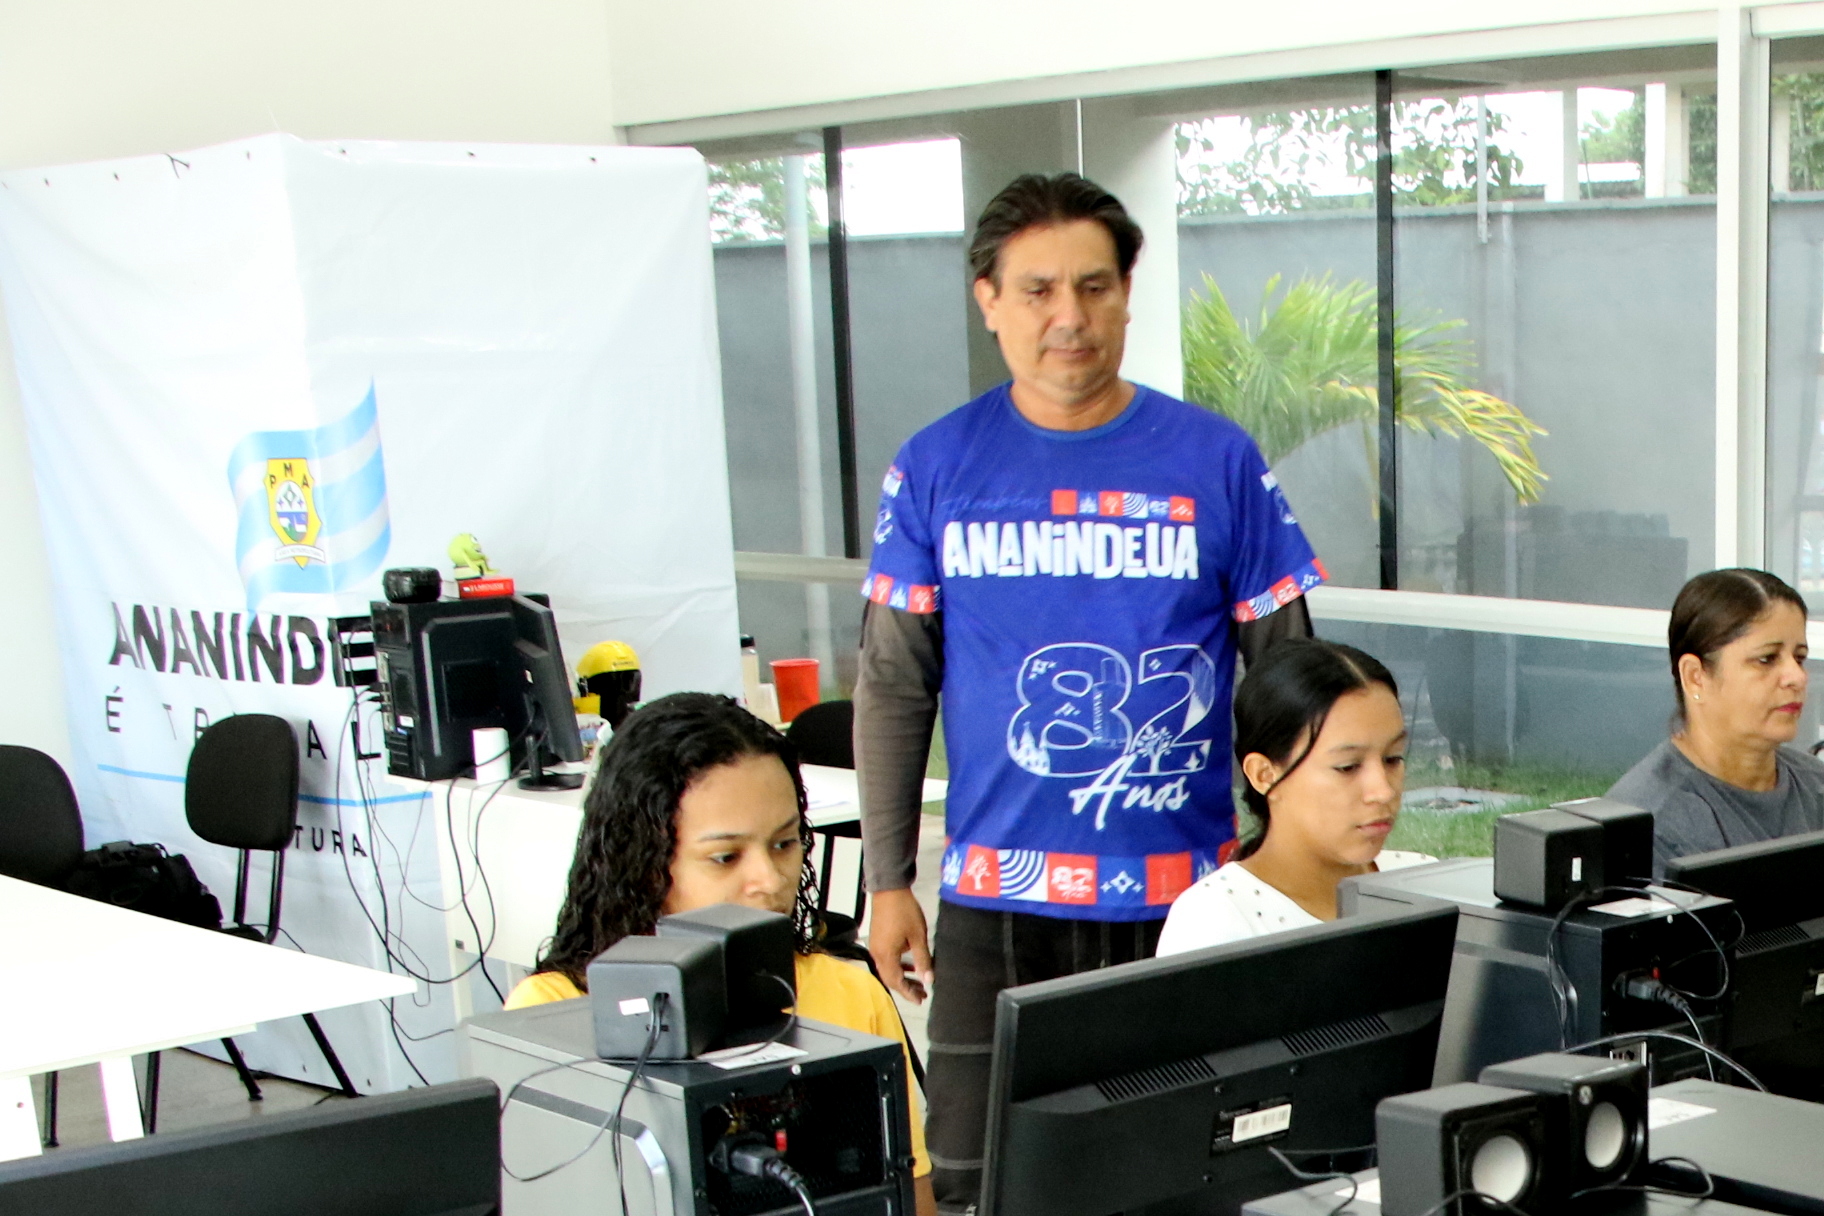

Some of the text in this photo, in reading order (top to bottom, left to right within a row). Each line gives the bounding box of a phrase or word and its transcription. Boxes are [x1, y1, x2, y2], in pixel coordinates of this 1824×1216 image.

[108, 601, 378, 688] ANANINDE
[104, 686, 124, 733] É
[1007, 642, 1216, 778] 82
[1068, 754, 1190, 831] Anos
